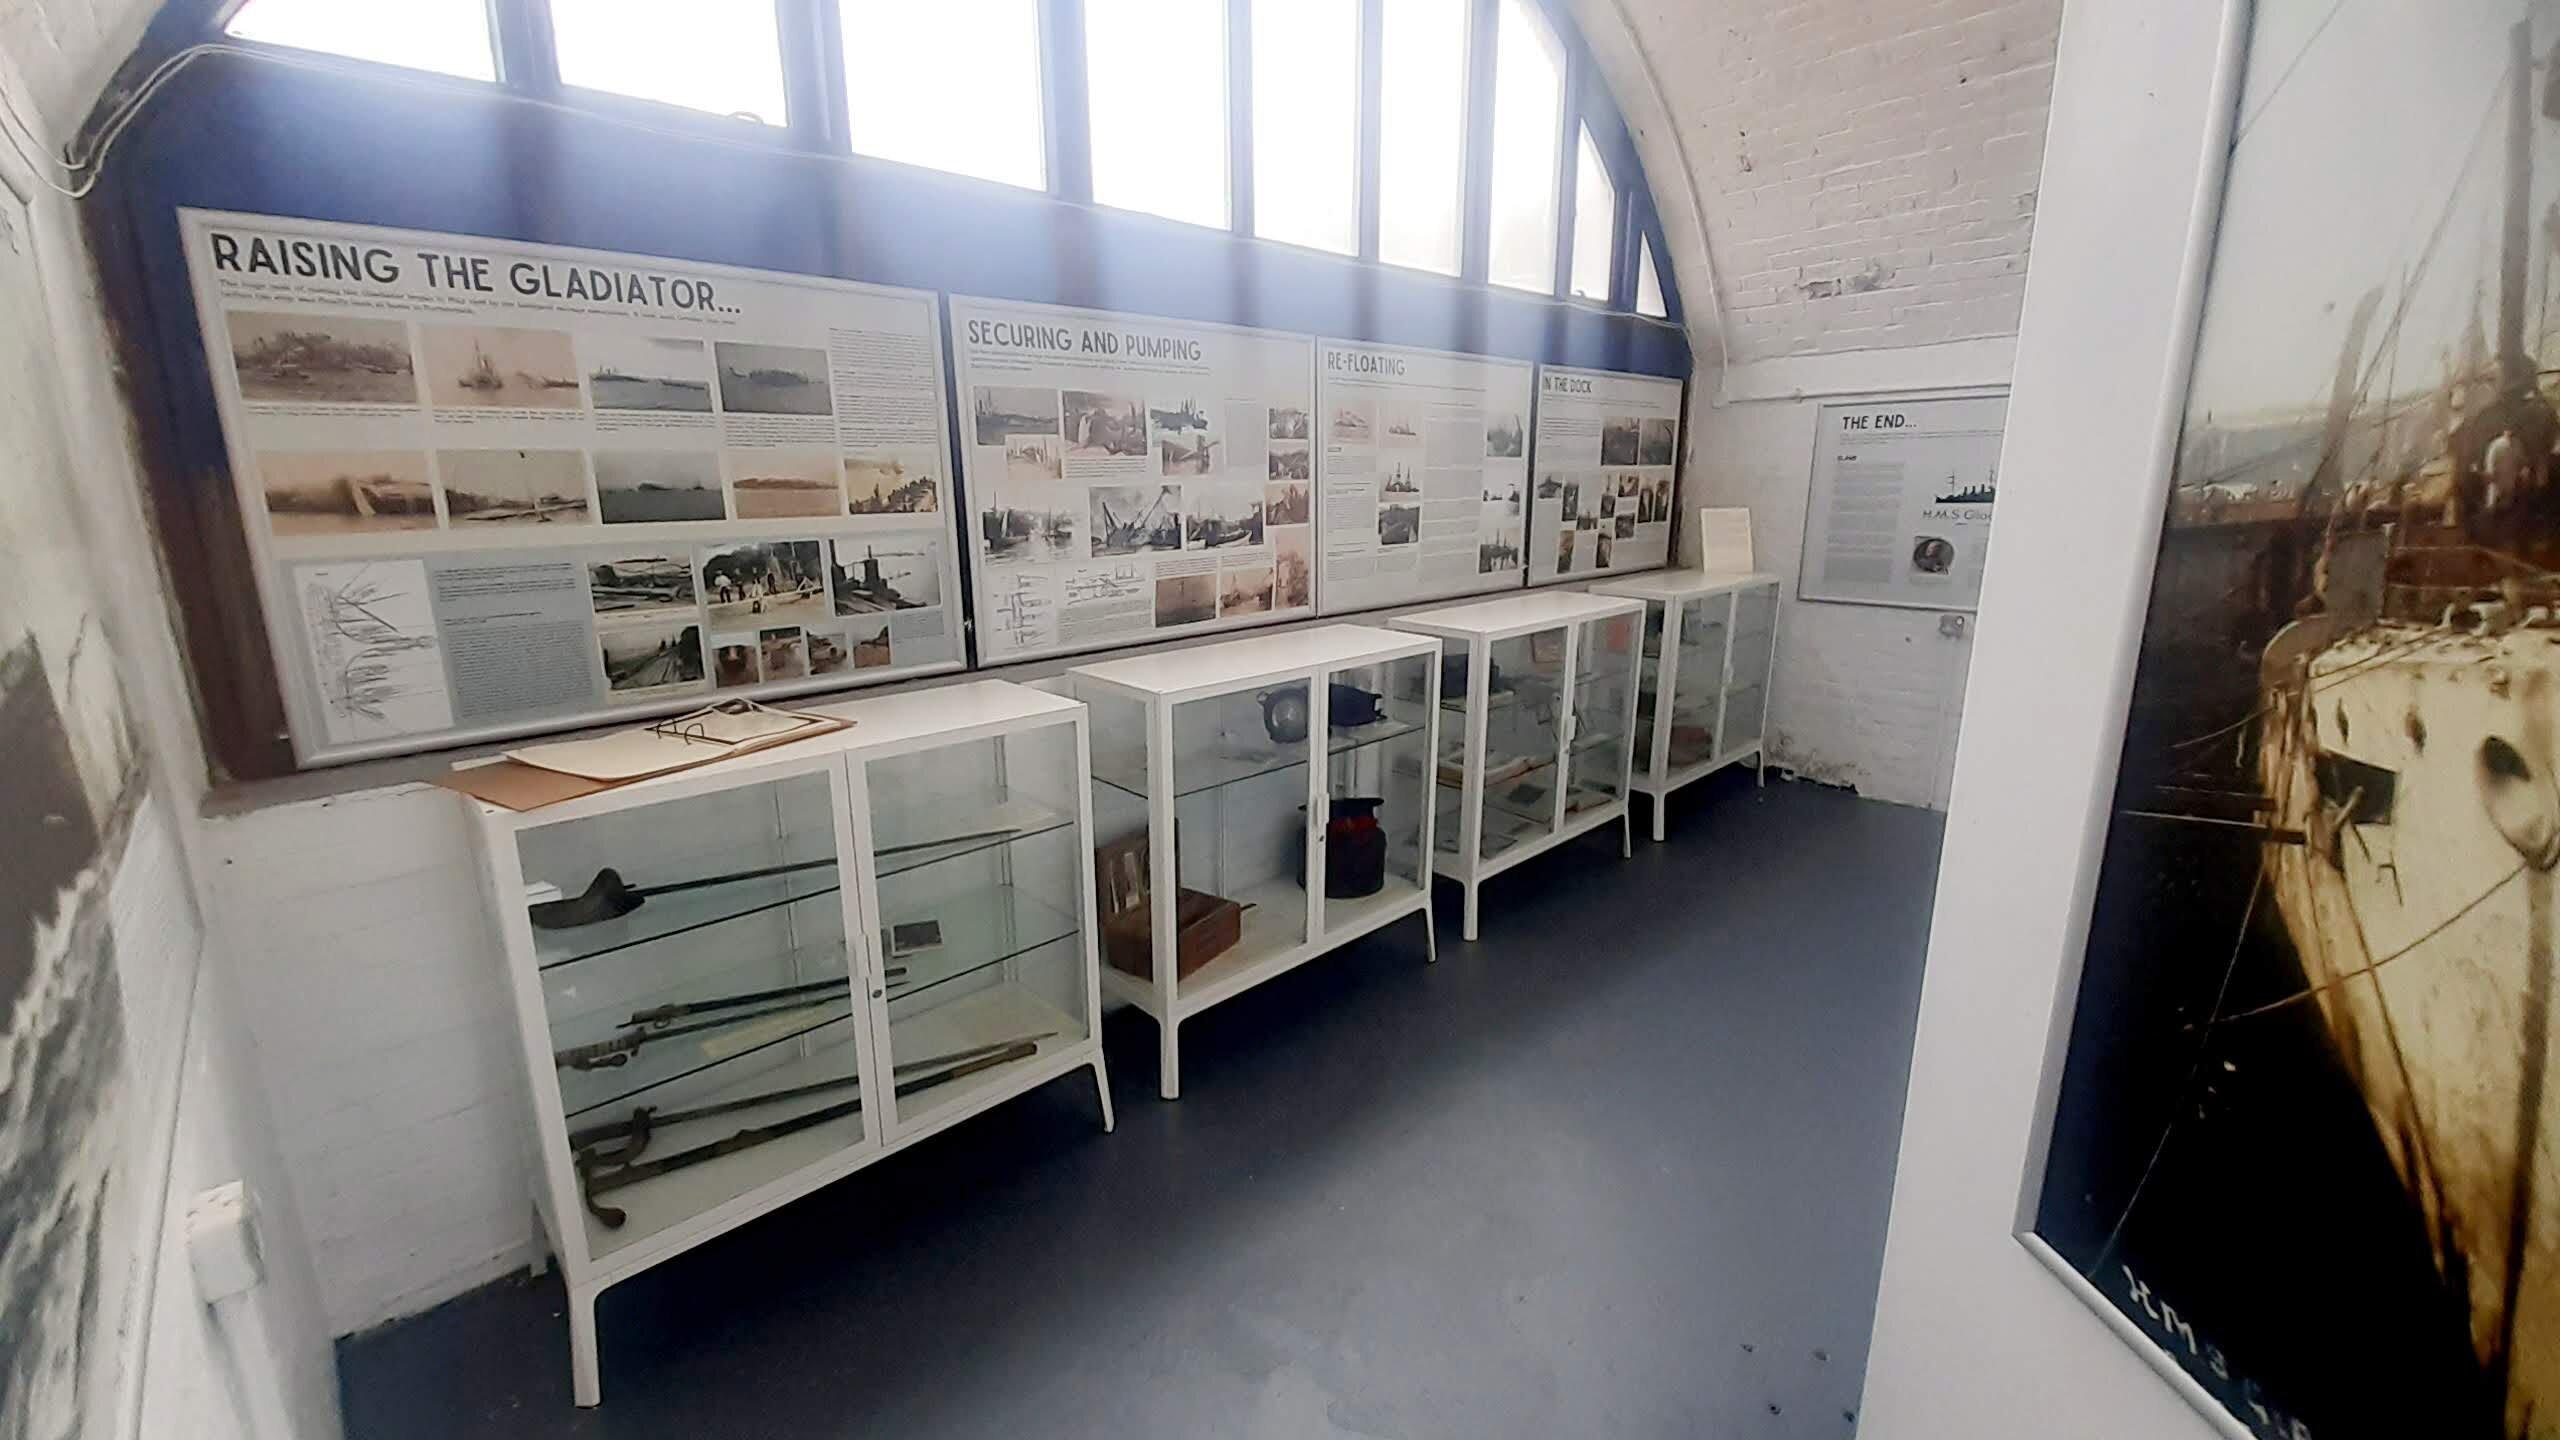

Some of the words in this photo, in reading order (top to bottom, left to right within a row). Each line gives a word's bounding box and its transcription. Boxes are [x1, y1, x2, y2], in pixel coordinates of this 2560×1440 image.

[210, 233, 399, 284] RAISING
[418, 252, 493, 293] THE
[509, 261, 741, 314] GLADIATOR...
[968, 319, 1072, 352] SECURING
[1081, 330, 1119, 354] AND
[1125, 337, 1201, 361] PUMPING
[1328, 352, 1405, 376] RE-FLOATING
[1842, 415, 1869, 430] THE
[1875, 414, 1917, 428] END...
